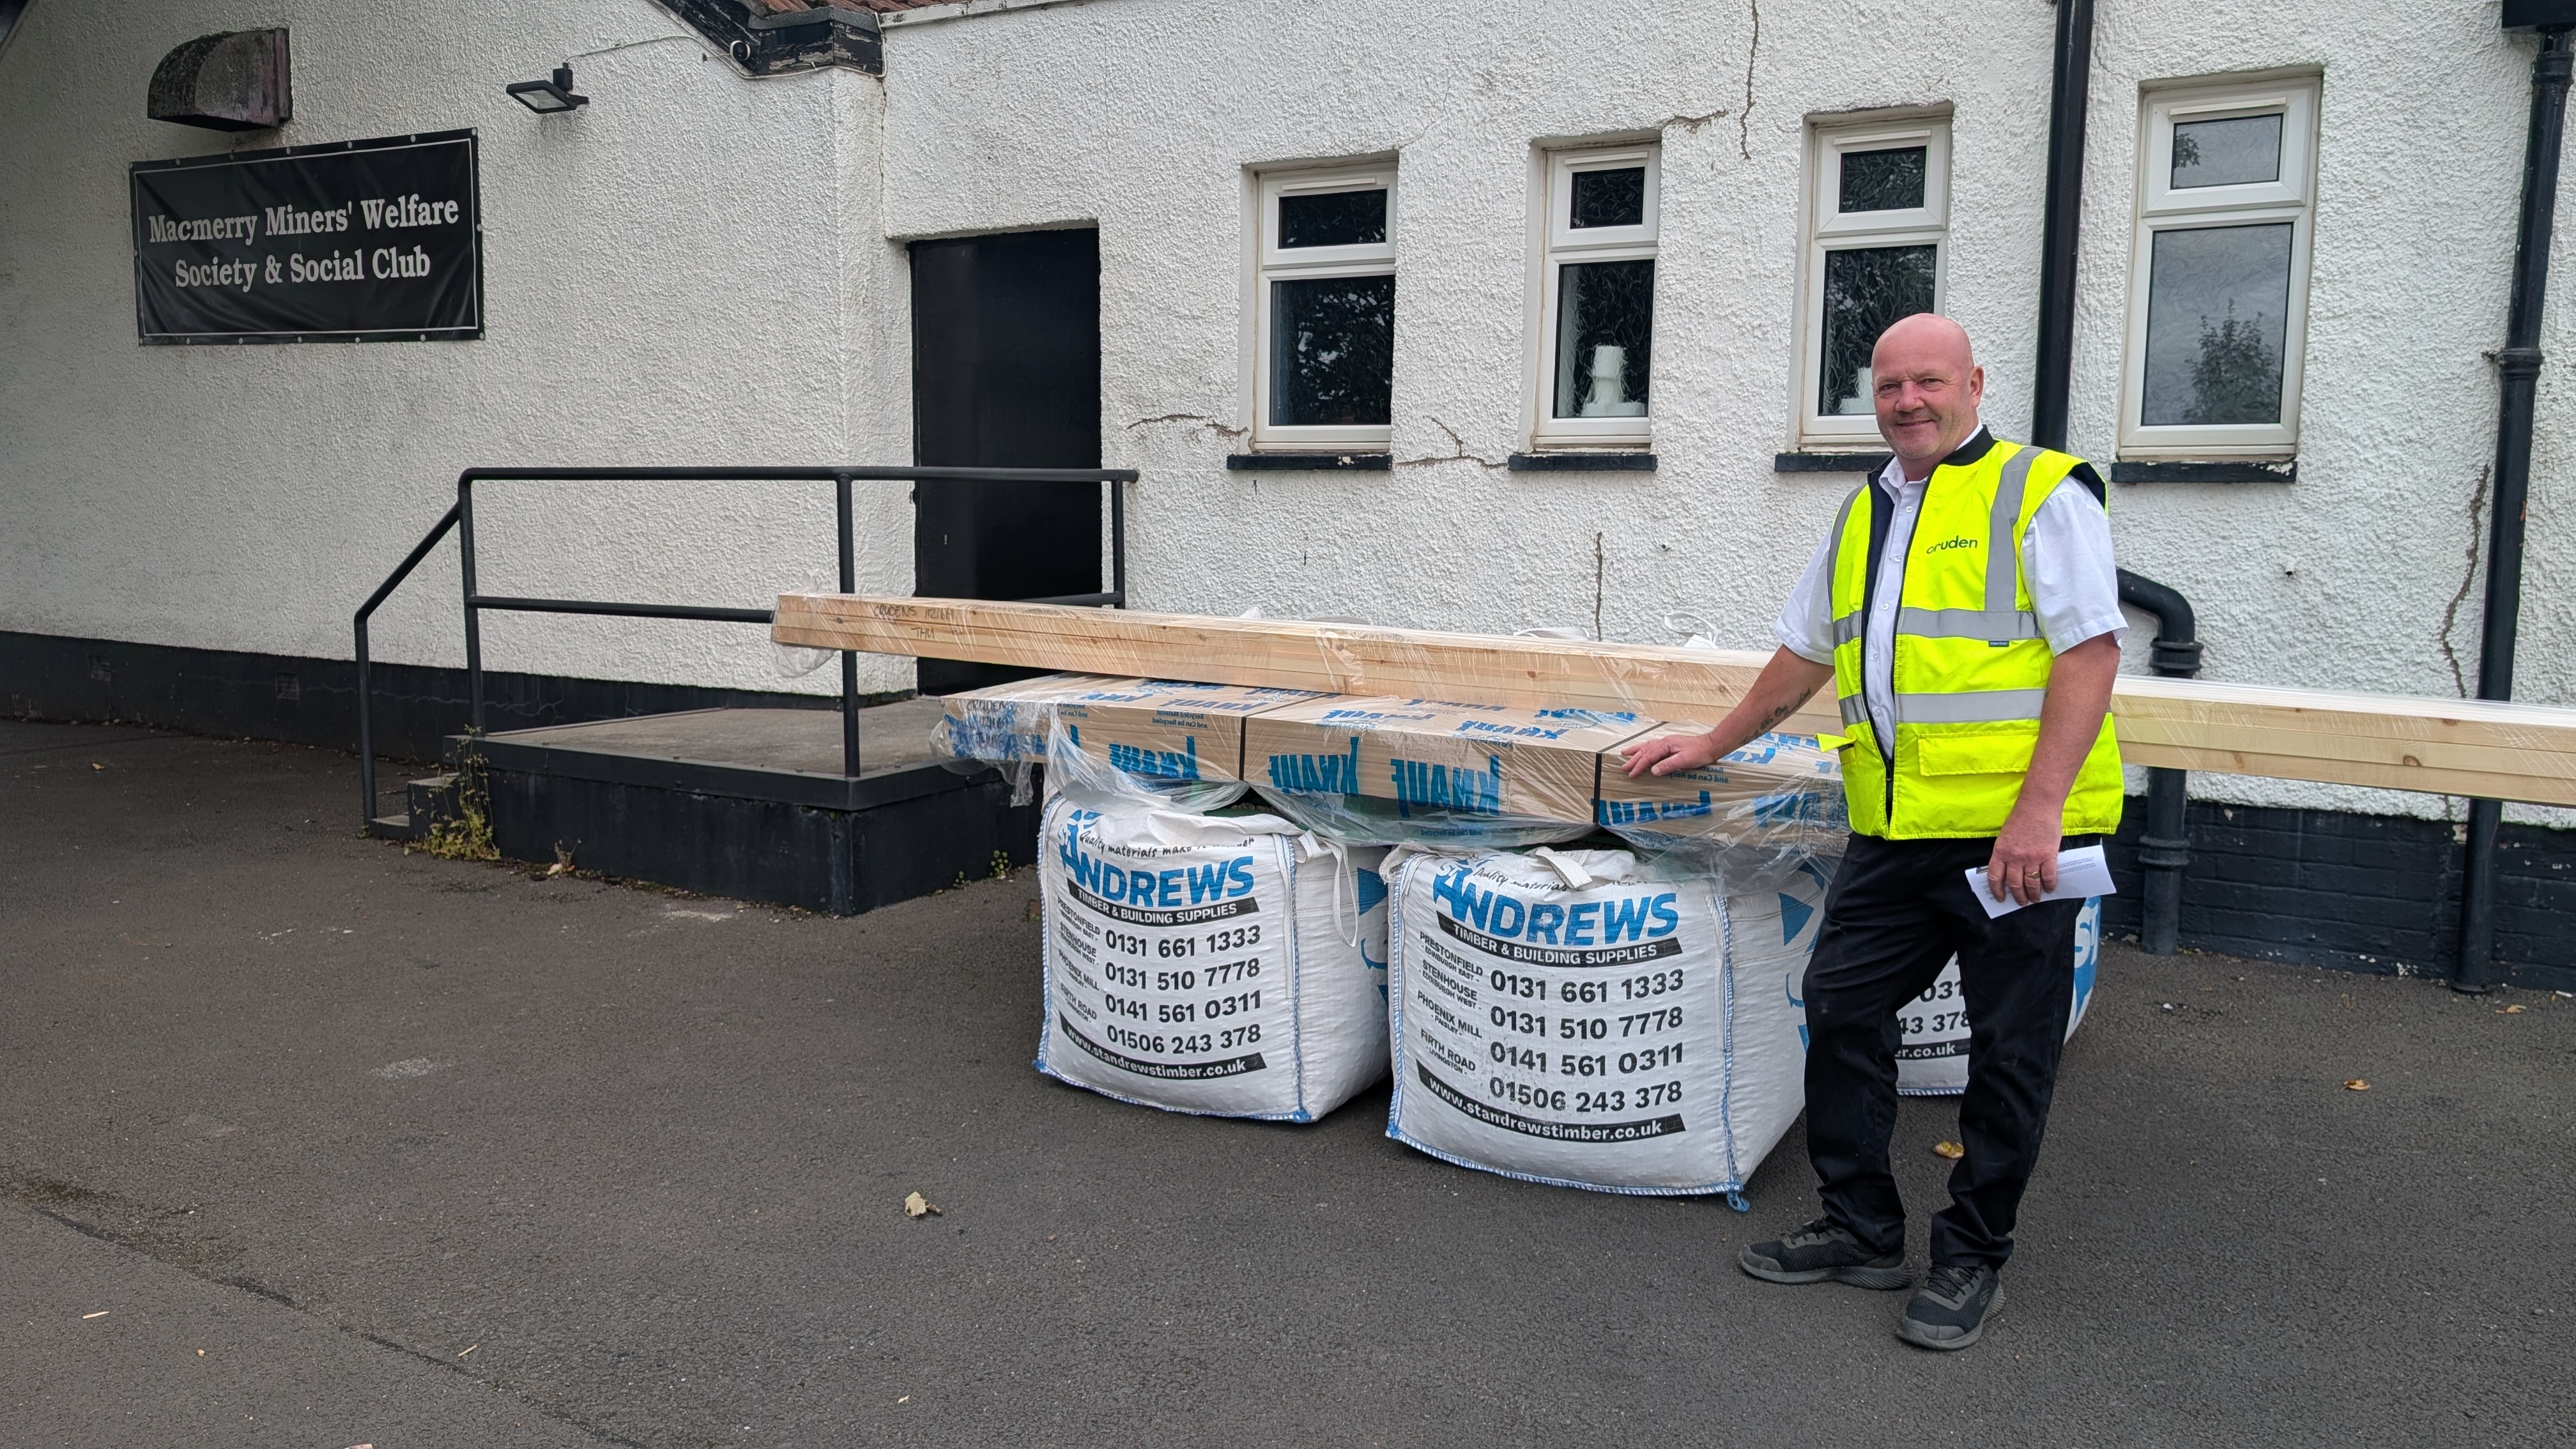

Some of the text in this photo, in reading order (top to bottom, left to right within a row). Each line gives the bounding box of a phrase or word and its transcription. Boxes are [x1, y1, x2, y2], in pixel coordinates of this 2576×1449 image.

[149, 194, 459, 245] Macmerry Miners' Welfare
[175, 245, 430, 292] Society & Social Club
[1926, 535, 1977, 554] cruden
[873, 604, 917, 618] CRUDENS
[911, 627, 935, 639] THU
[1080, 831, 1105, 855] Quality
[1108, 845, 1157, 857] materials
[1059, 823, 1254, 908] ANDREWS
[1473, 868, 1508, 887] Quality
[1057, 896, 1100, 935] PRESTONFIELD
[1078, 888, 1238, 924] TIMBER & BUILDING SUPPLIES
[1433, 865, 1679, 946] ANDREWS
[1060, 921, 1096, 958] STENHOUSE
[1106, 924, 1261, 958] 0131 661 1333
[1420, 931, 1483, 976] PRESTONFIELD
[1453, 924, 1657, 965] TIMBER & BUILDING SUPPLIES
[1105, 958, 1260, 991] 0131 510 7778
[1423, 959, 1477, 1001] STENHOUSE
[1425, 946, 1474, 981] EDINBURGH EAST
[1084, 973, 1100, 991] MILL
[1422, 970, 1476, 1009] EDINBURGH WEST
[1491, 969, 1683, 1003] 0131 661 1333
[1919, 981, 1963, 1002] 031
[1078, 1000, 1097, 1020] ROAD
[1105, 990, 1261, 1022] 0141 561 0311
[1418, 990, 1482, 1039] PHOENIX MILL
[1491, 1006, 1683, 1039] 0131 510 7778
[1107, 1023, 1261, 1054] 01506 243 378
[1435, 1015, 1458, 1034] PAISLEY
[1066, 1025, 1246, 1077] www.standrewstimber.co.uk
[1421, 1028, 1476, 1071] FIRTH ROAD
[1491, 1041, 1683, 1077] 0141 561 0311
[1428, 1077, 1662, 1140] www.standrewstimber.co.uk
[1489, 1077, 1682, 1113] 01506 243 378
